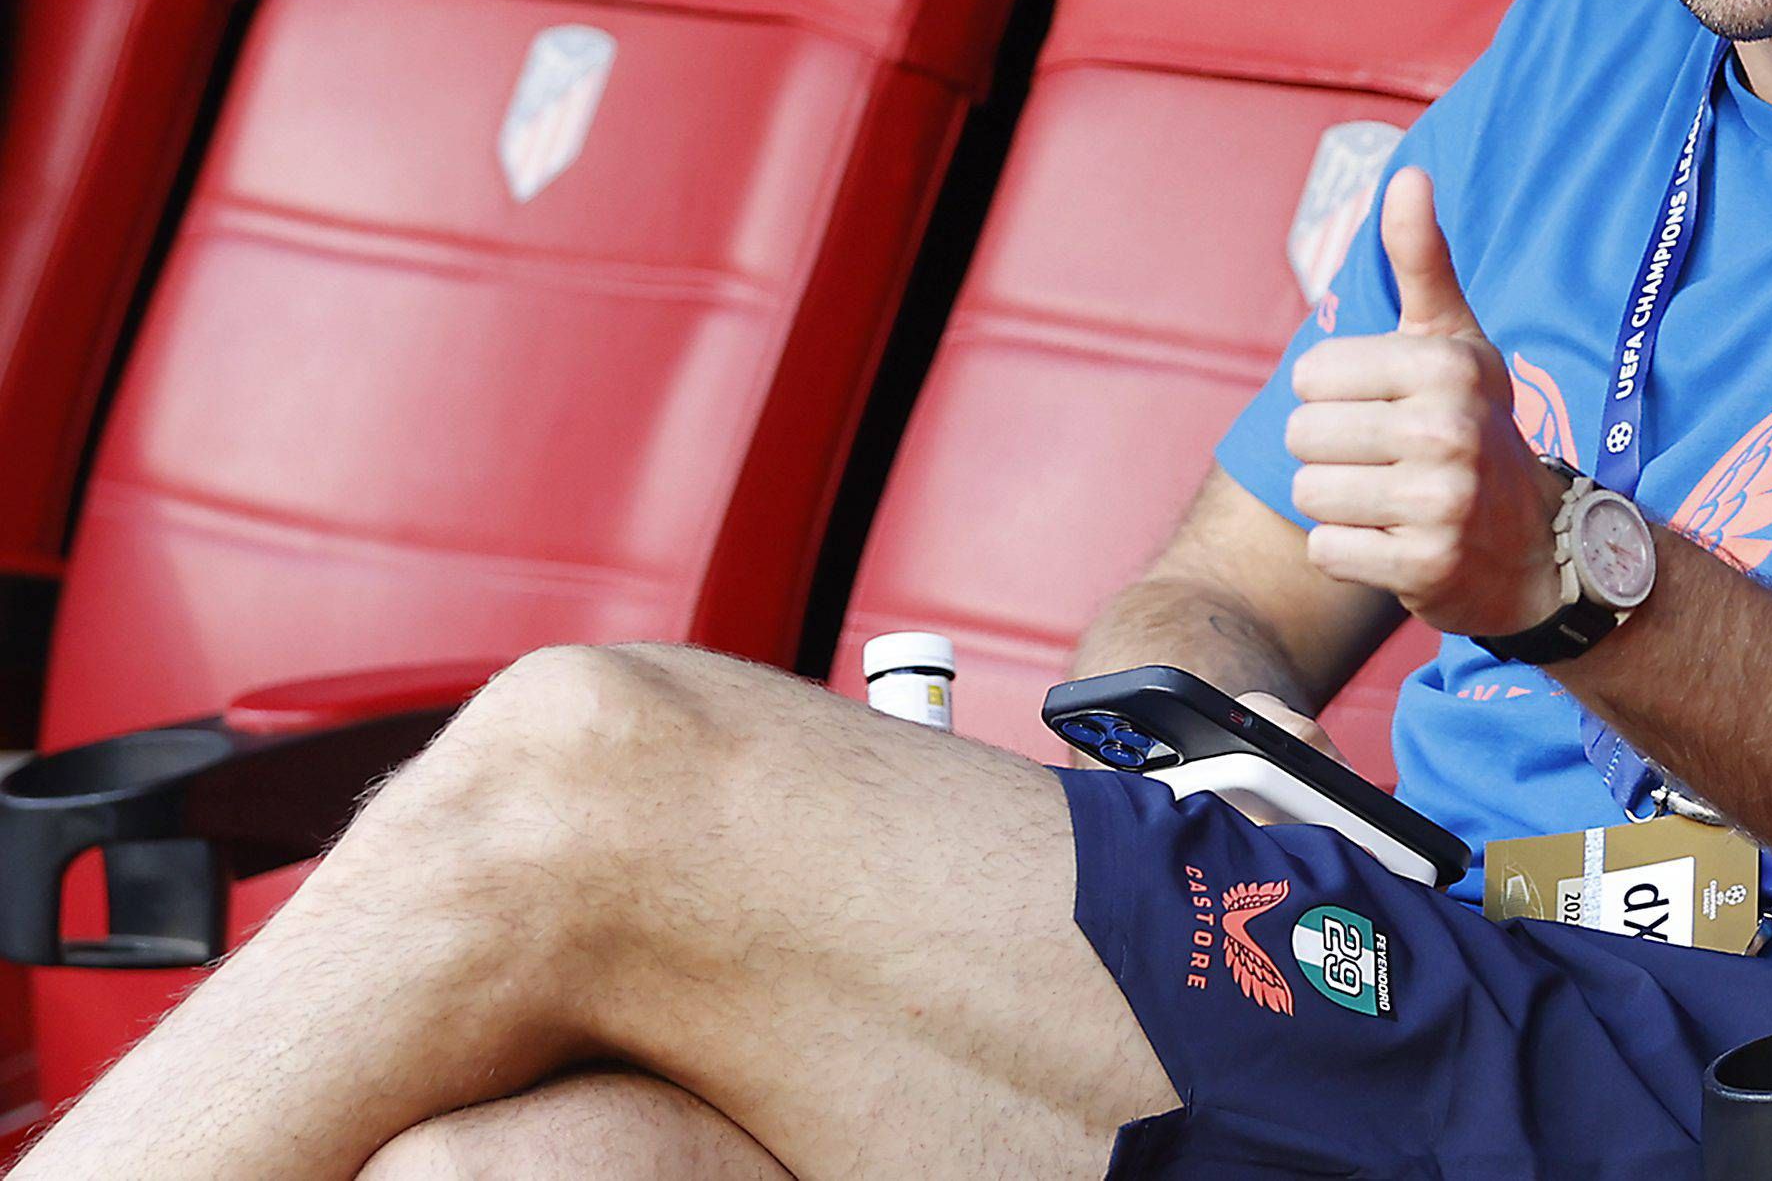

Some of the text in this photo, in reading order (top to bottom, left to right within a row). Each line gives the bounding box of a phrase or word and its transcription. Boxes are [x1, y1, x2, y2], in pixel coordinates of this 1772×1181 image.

[1615, 330, 1645, 400] UEFA
[1631, 190, 1688, 328] CHAMPIONS
[1185, 865, 1215, 990] CASTORE
[1563, 891, 1582, 926] 202
[1323, 917, 1362, 996] 29
[1375, 933, 1391, 1011] FEYENOORD
